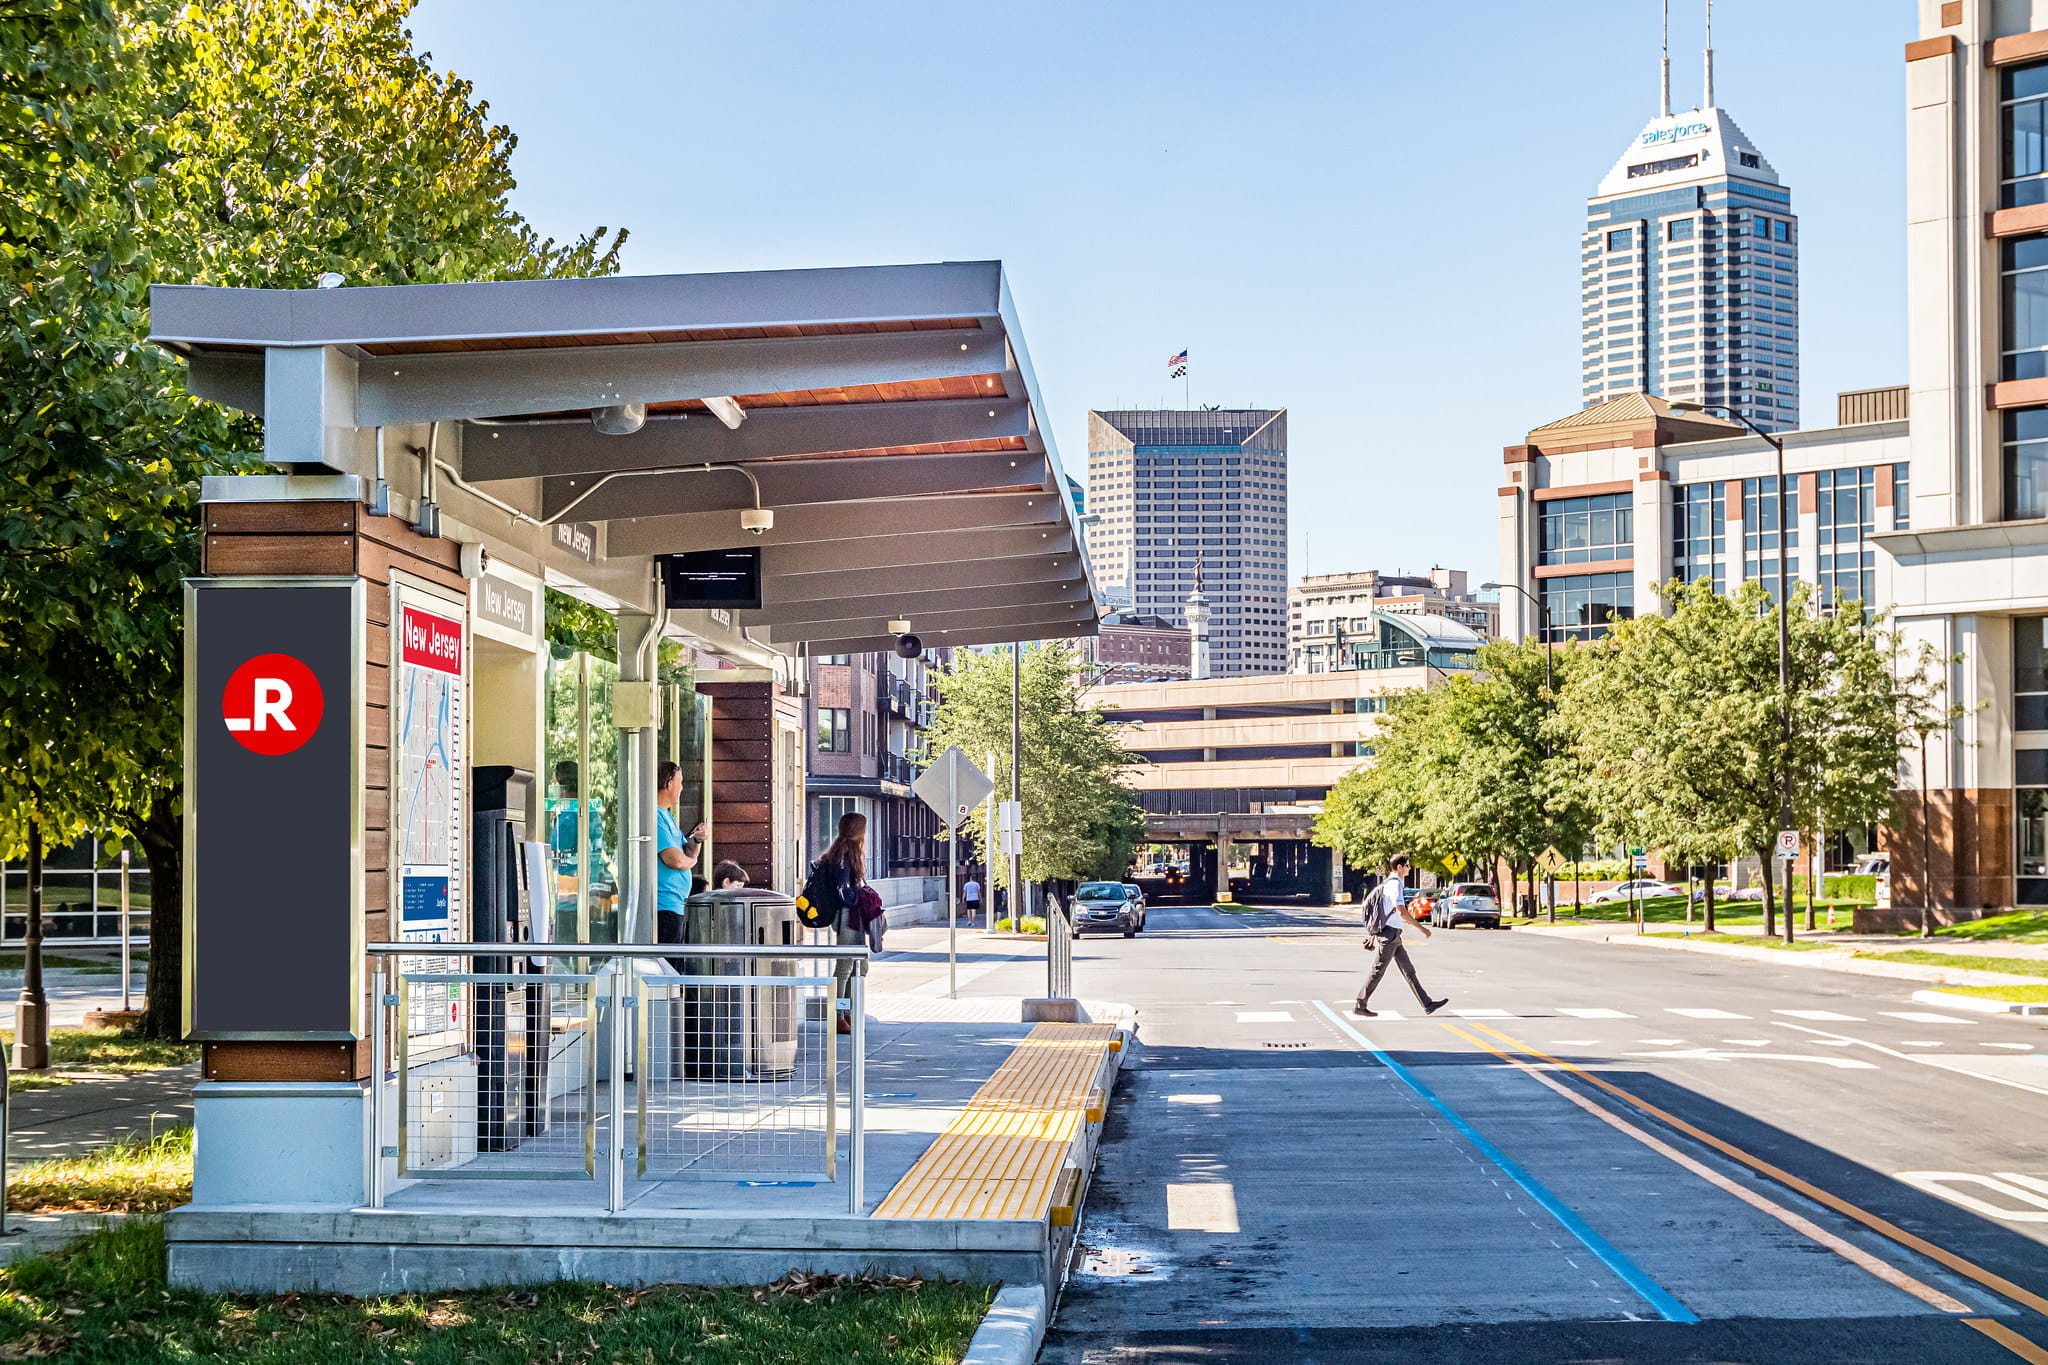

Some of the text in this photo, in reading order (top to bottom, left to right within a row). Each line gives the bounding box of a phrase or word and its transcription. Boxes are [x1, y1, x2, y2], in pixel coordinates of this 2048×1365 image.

[1642, 123, 1707, 144] salesforce
[558, 523, 591, 561] New Jersey
[485, 582, 525, 631] New Jersey
[405, 614, 460, 669] New Jersey
